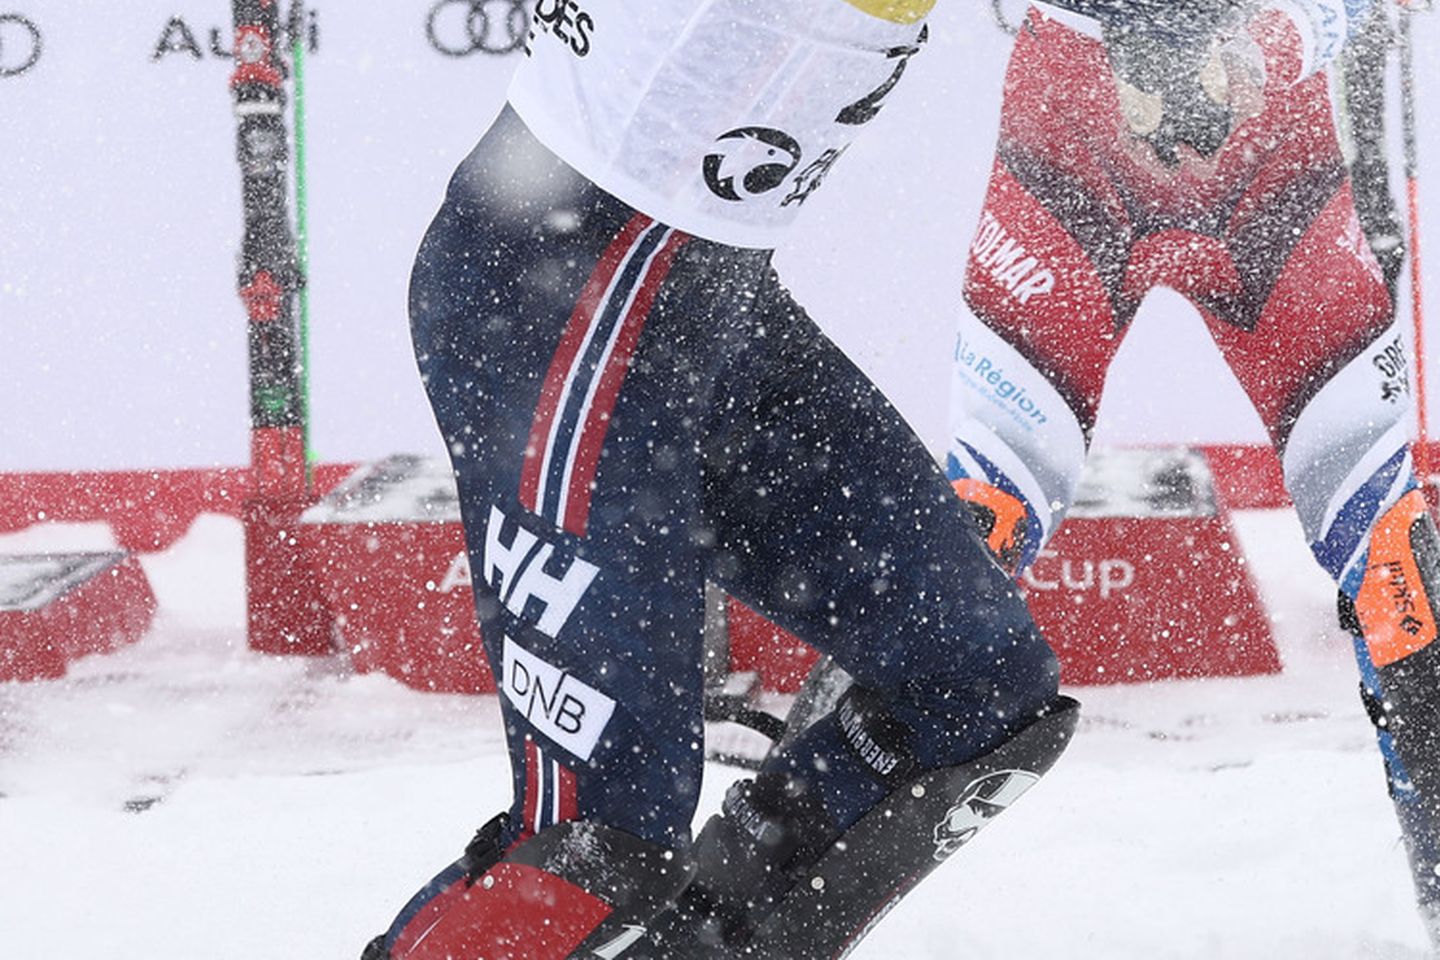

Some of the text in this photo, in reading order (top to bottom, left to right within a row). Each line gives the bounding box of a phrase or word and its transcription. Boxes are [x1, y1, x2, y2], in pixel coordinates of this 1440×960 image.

[152, 8, 320, 63] Aui
[974, 357, 1048, 425] Région
[1022, 548, 1136, 599] Cup
[510, 656, 588, 736] DNB
